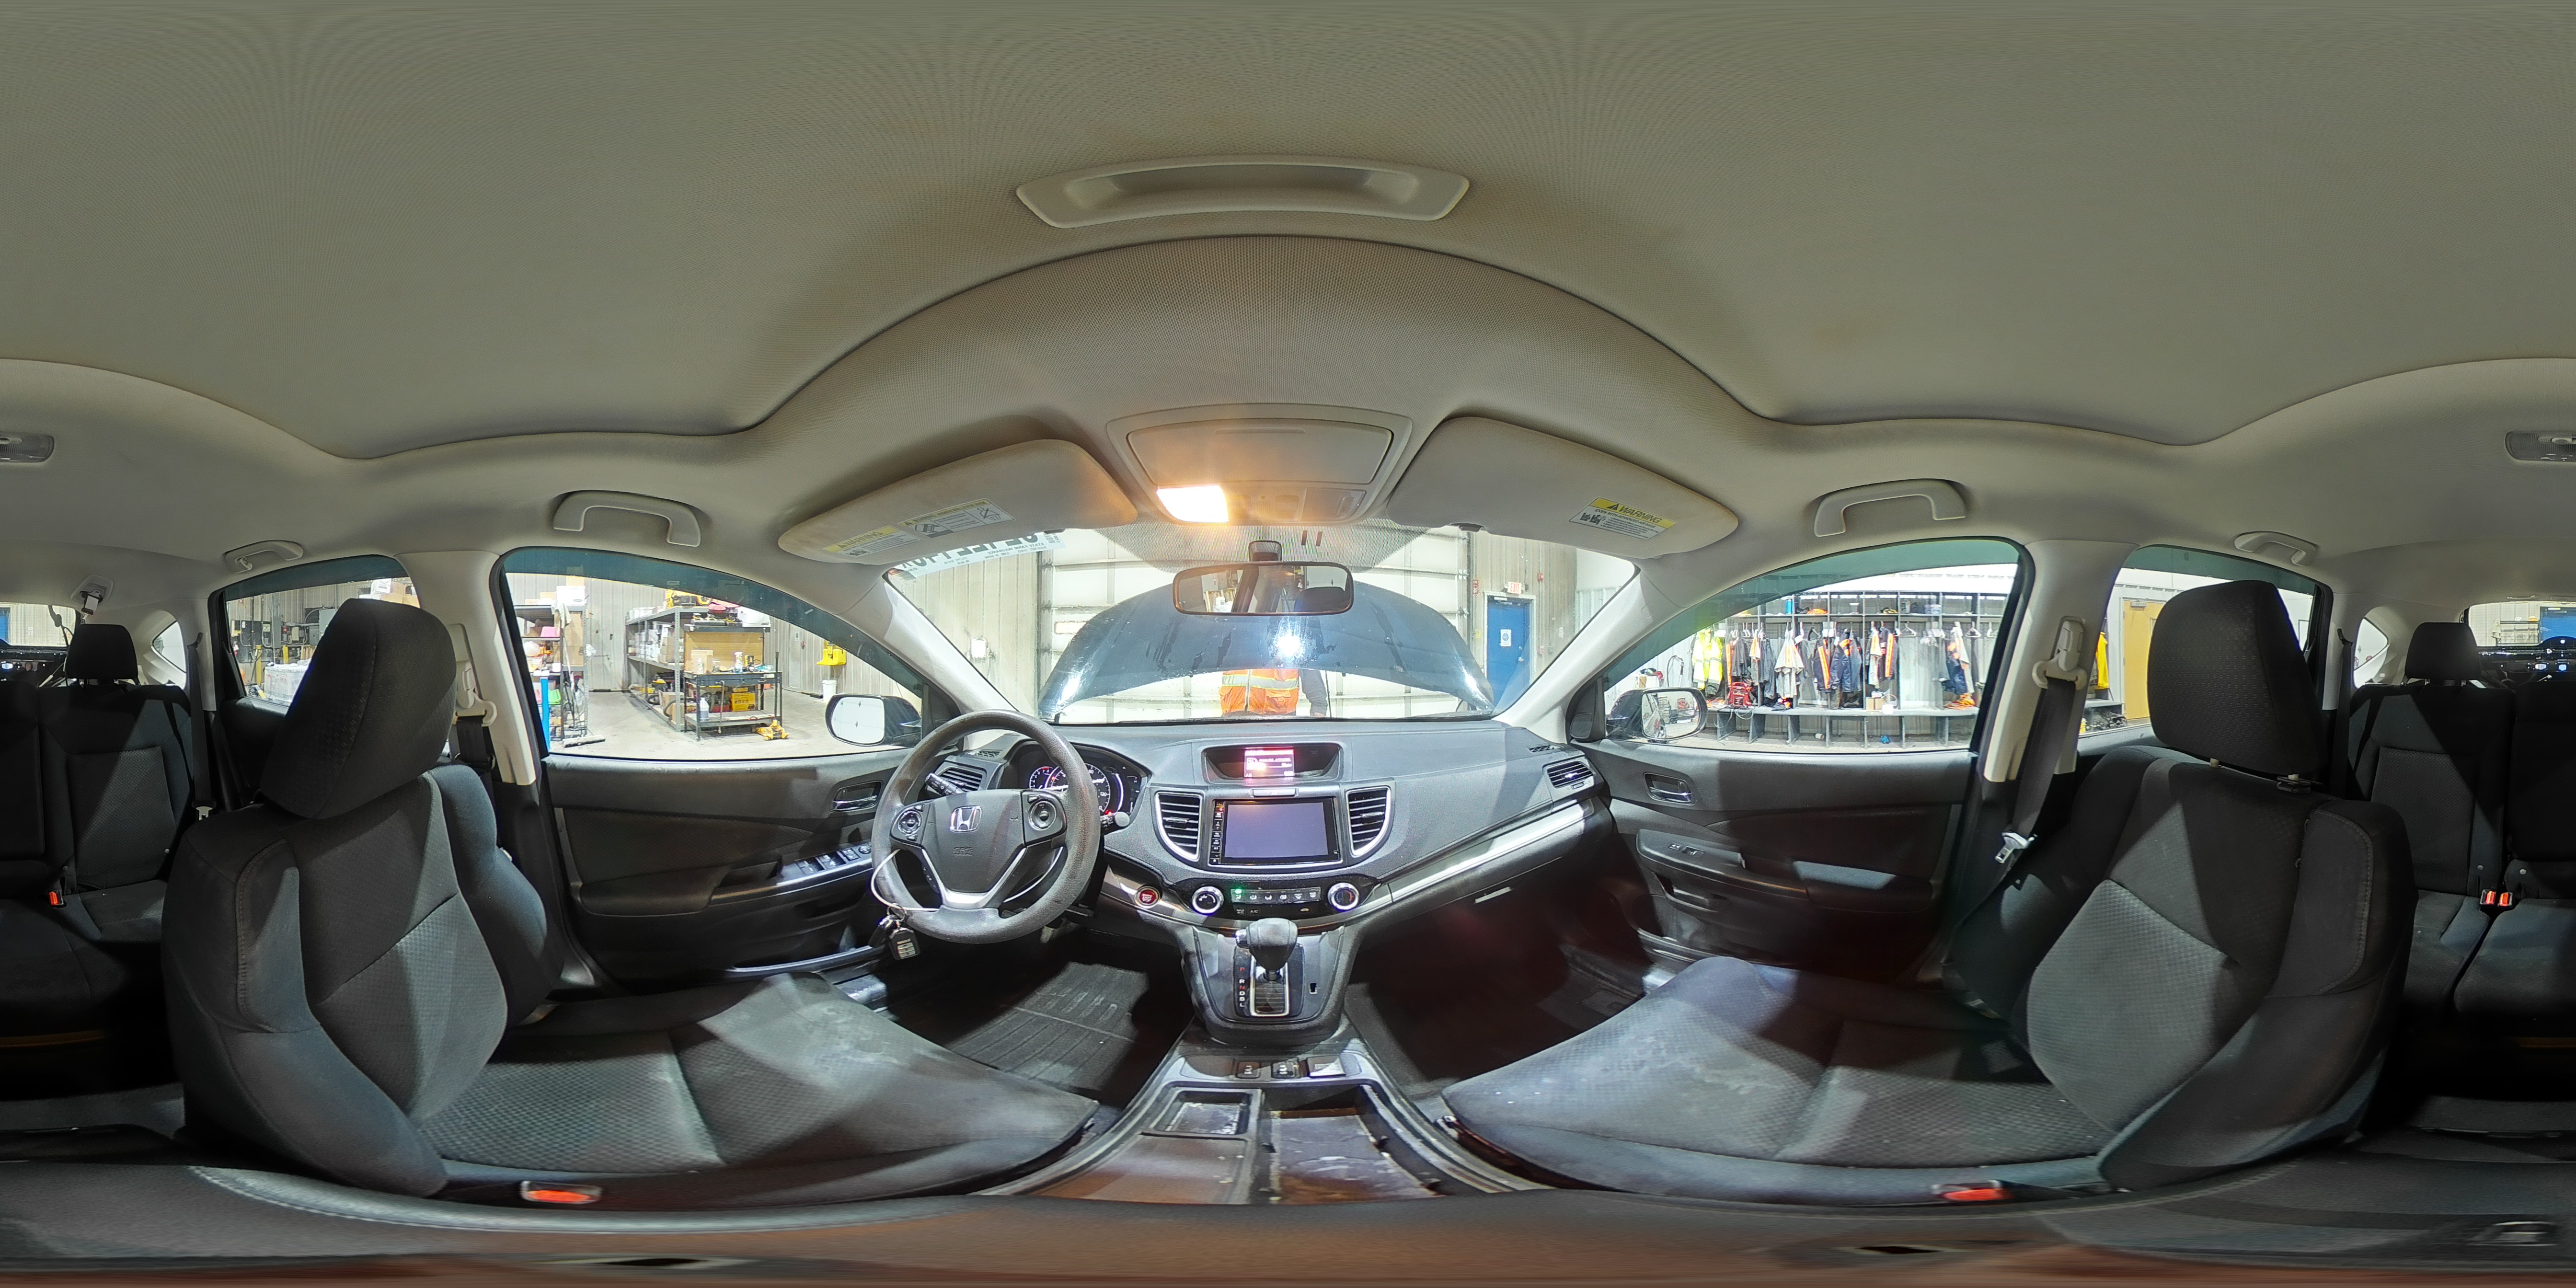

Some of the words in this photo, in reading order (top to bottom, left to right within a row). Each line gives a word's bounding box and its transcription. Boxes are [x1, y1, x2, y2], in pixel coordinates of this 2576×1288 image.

[1619, 506, 1662, 523] WARNING
[843, 531, 884, 545] WARNING
[1510, 583, 1519, 593] EXIT
